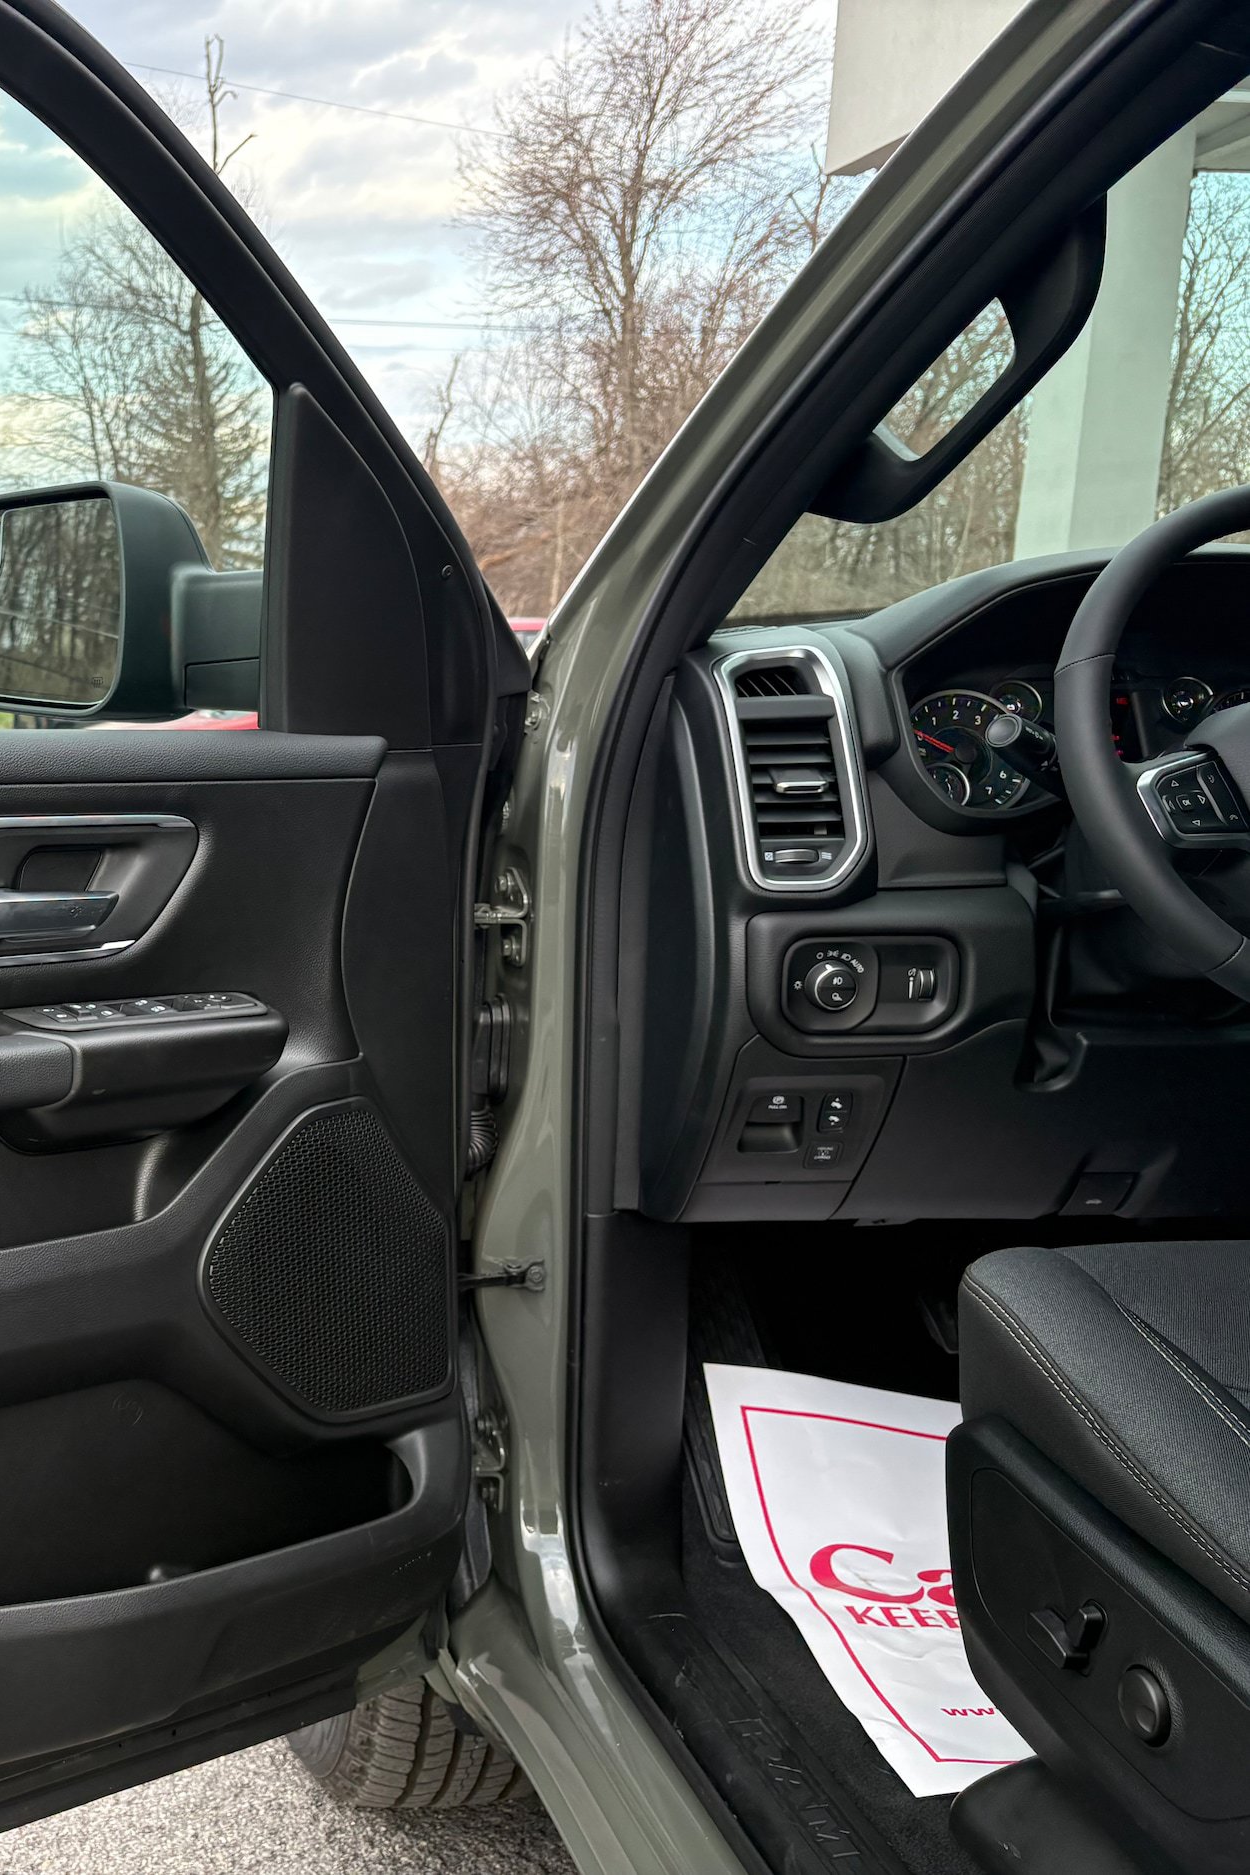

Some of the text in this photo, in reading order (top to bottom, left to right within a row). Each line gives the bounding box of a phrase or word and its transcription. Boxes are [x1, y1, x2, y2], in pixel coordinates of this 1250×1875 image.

[952, 710, 960, 720] 2
[973, 715, 982, 726] 3
[999, 770, 1007, 779] 6
[850, 958, 865, 974] AUTO
